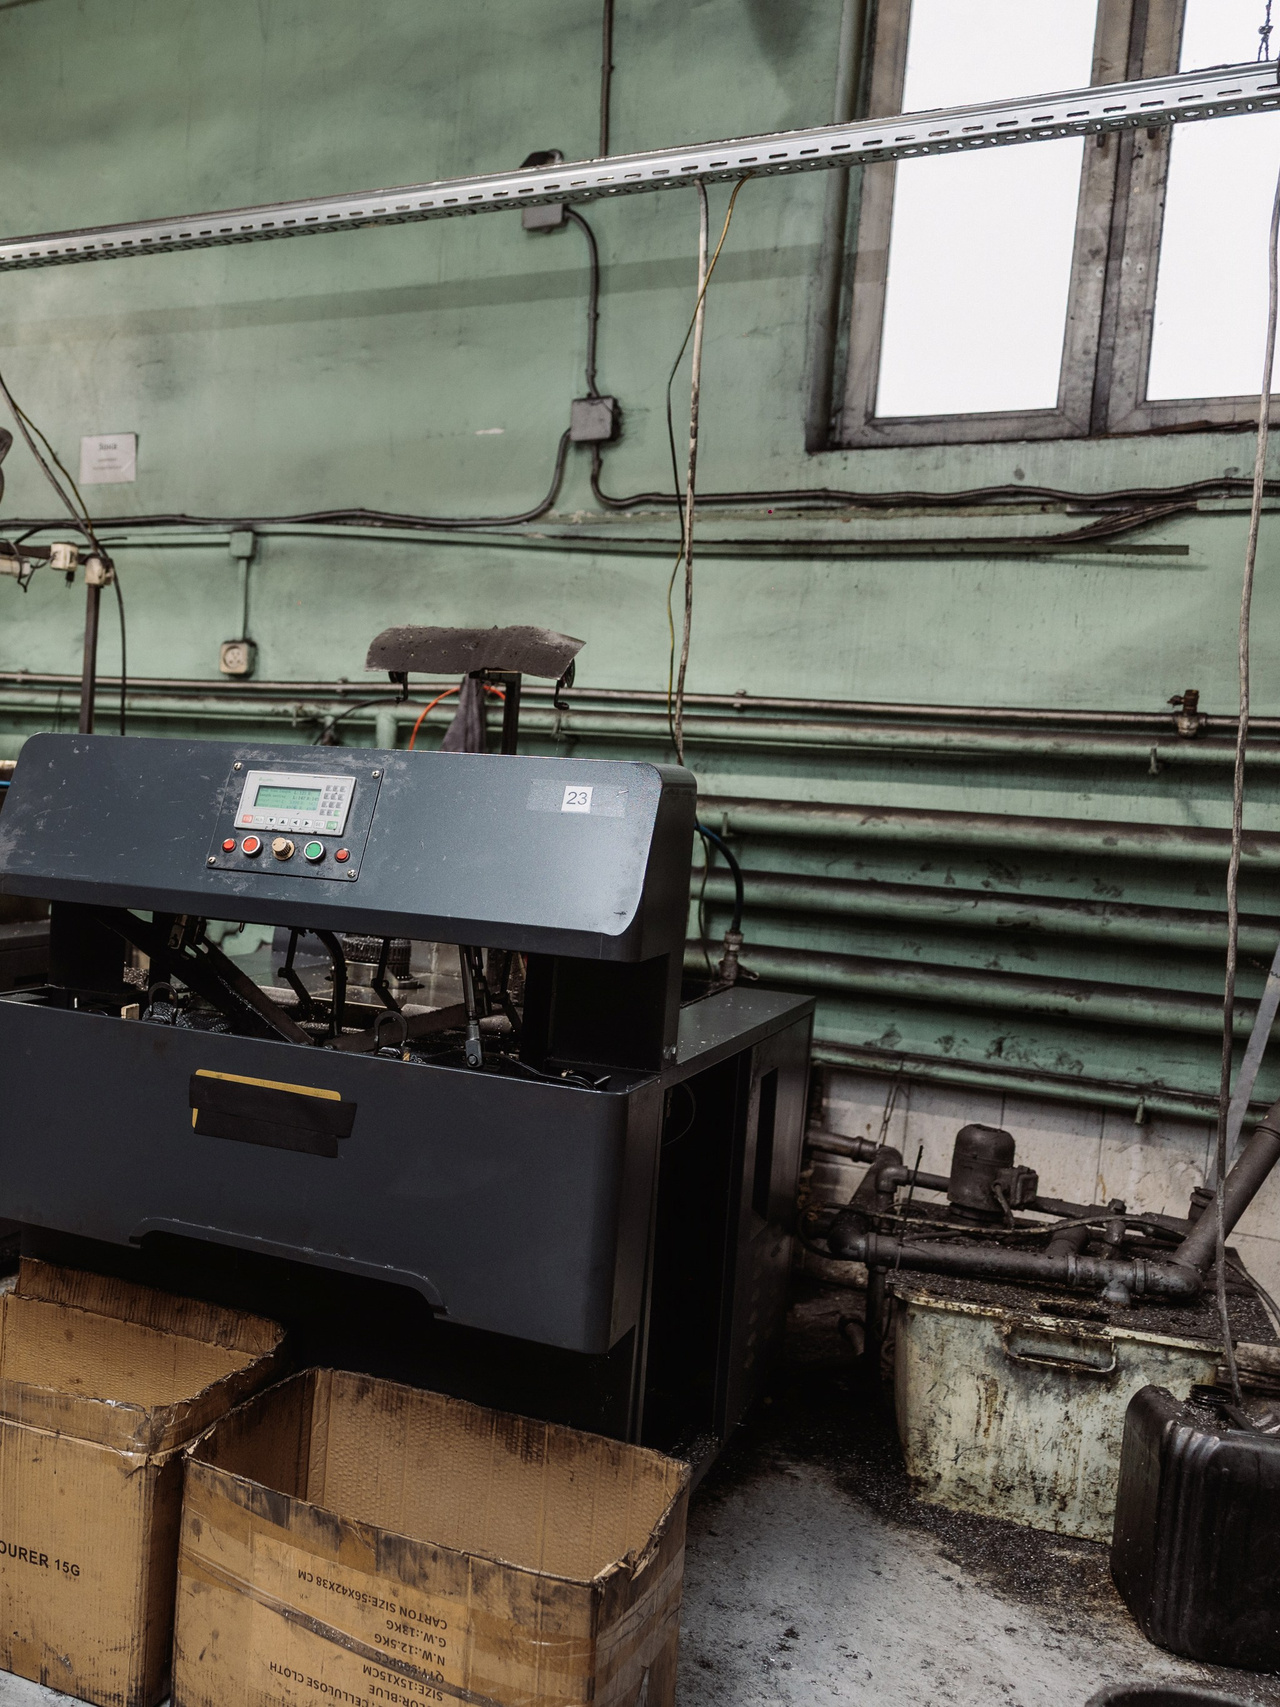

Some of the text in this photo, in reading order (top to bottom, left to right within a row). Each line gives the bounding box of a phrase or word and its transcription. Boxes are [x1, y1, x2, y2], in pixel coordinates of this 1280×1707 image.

[566, 791, 588, 805] 23
[54, 1559, 81, 1577] 15G
[298, 1569, 448, 1630] CARTON SIZE:56X42X38 CM
[374, 1633, 445, 1666] N.W.:12.5KG
[386, 1620, 446, 1648] G.W.:13KG
[269, 1661, 369, 1707] CELLULOSE CLOTH
[363, 1664, 443, 1702] SIZE:15X15CM
